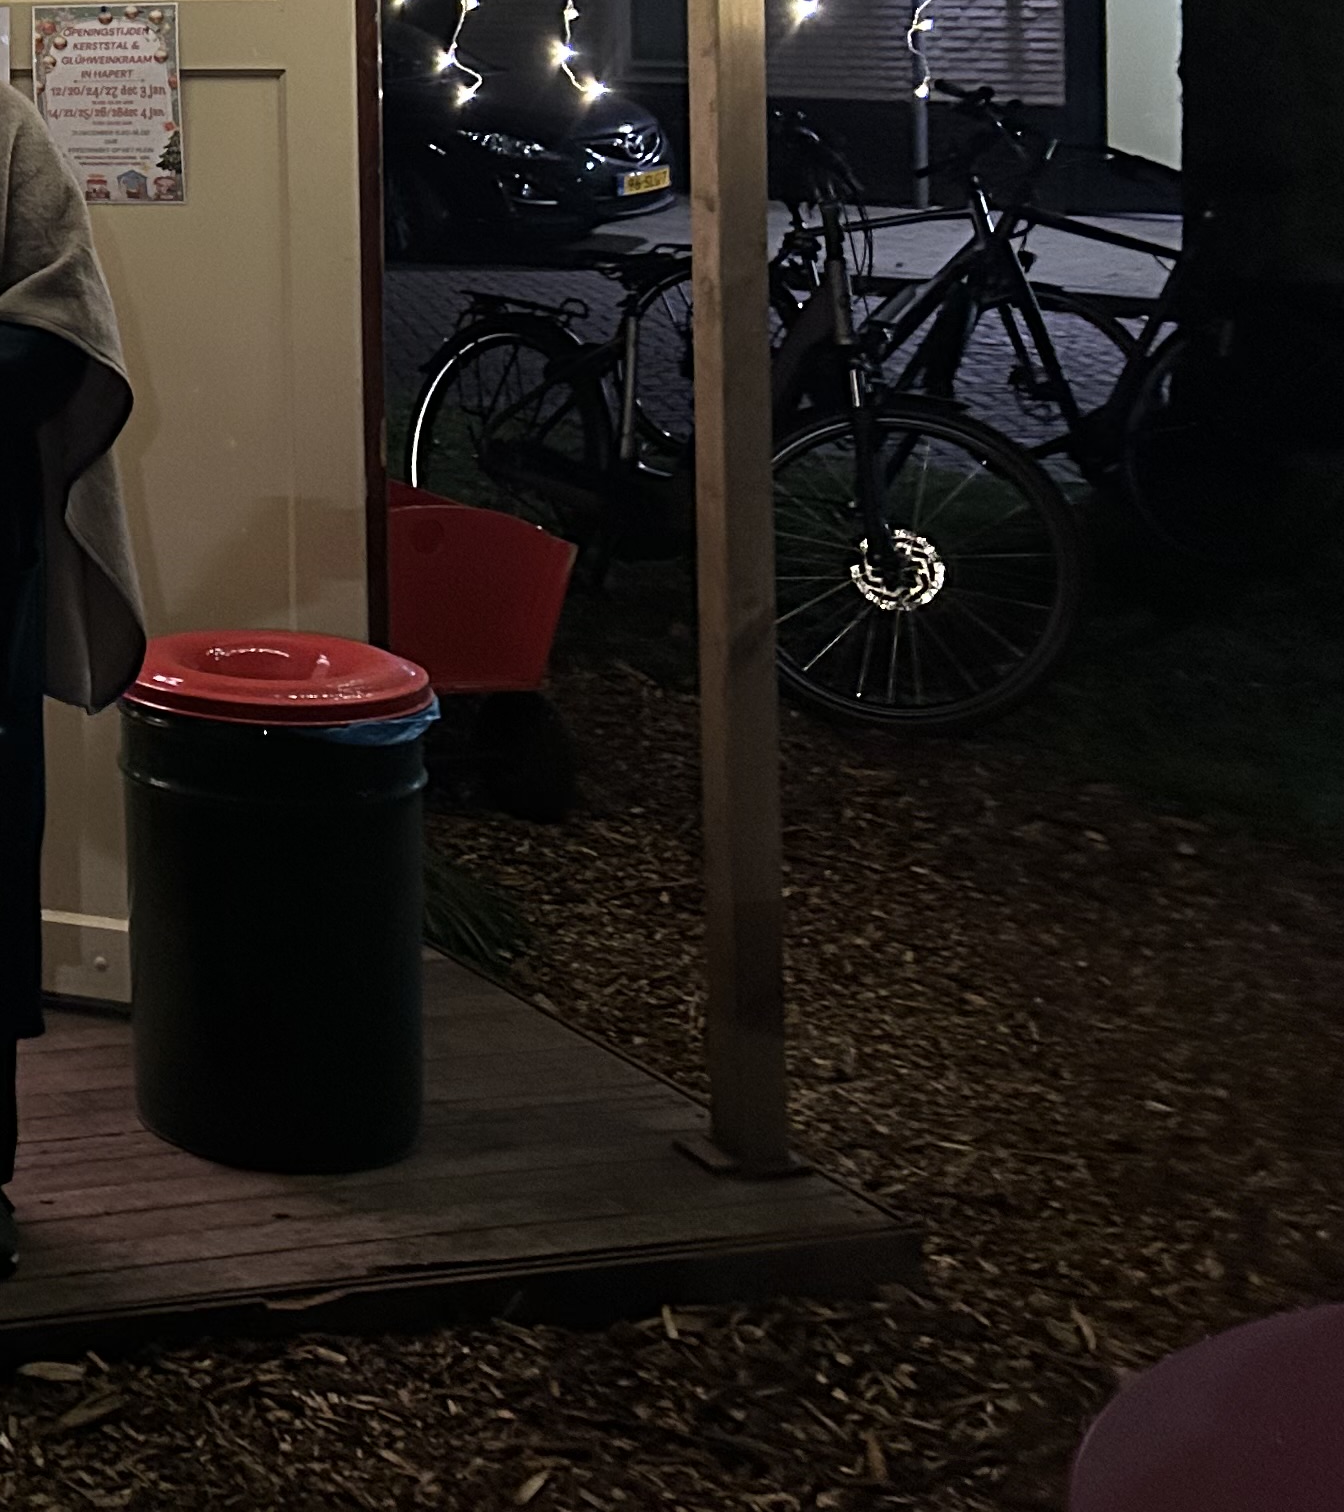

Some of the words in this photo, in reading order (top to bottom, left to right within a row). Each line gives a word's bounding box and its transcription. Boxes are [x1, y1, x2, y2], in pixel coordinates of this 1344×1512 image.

[72, 41, 129, 51] KERSTSTAL
[131, 40, 140, 50] &
[61, 53, 153, 65] GLÜHWEINKRAAM
[80, 70, 91, 79] IN
[93, 70, 134, 79] HAPERT
